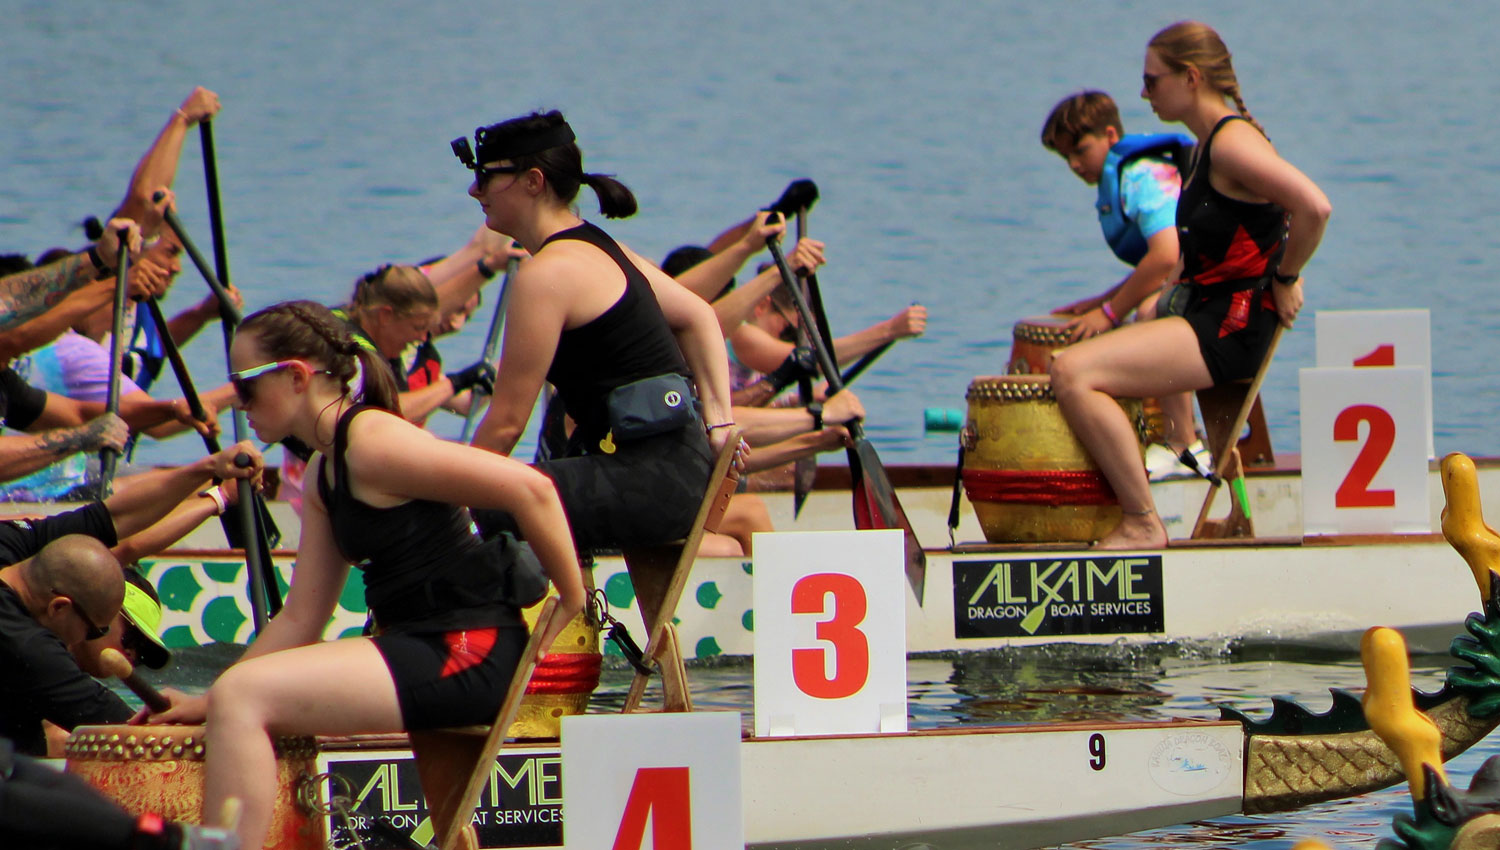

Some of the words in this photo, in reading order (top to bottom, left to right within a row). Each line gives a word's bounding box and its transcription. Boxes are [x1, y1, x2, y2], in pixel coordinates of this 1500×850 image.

[1333, 403, 1396, 508] 2
[968, 559, 1150, 604] ALKAME
[967, 605, 1028, 619] DRAGON
[1051, 603, 1085, 617] BOAT
[1090, 601, 1151, 615] SERVICES
[790, 573, 870, 700] 3
[1088, 733, 1106, 771] 9
[351, 757, 563, 812] ALME
